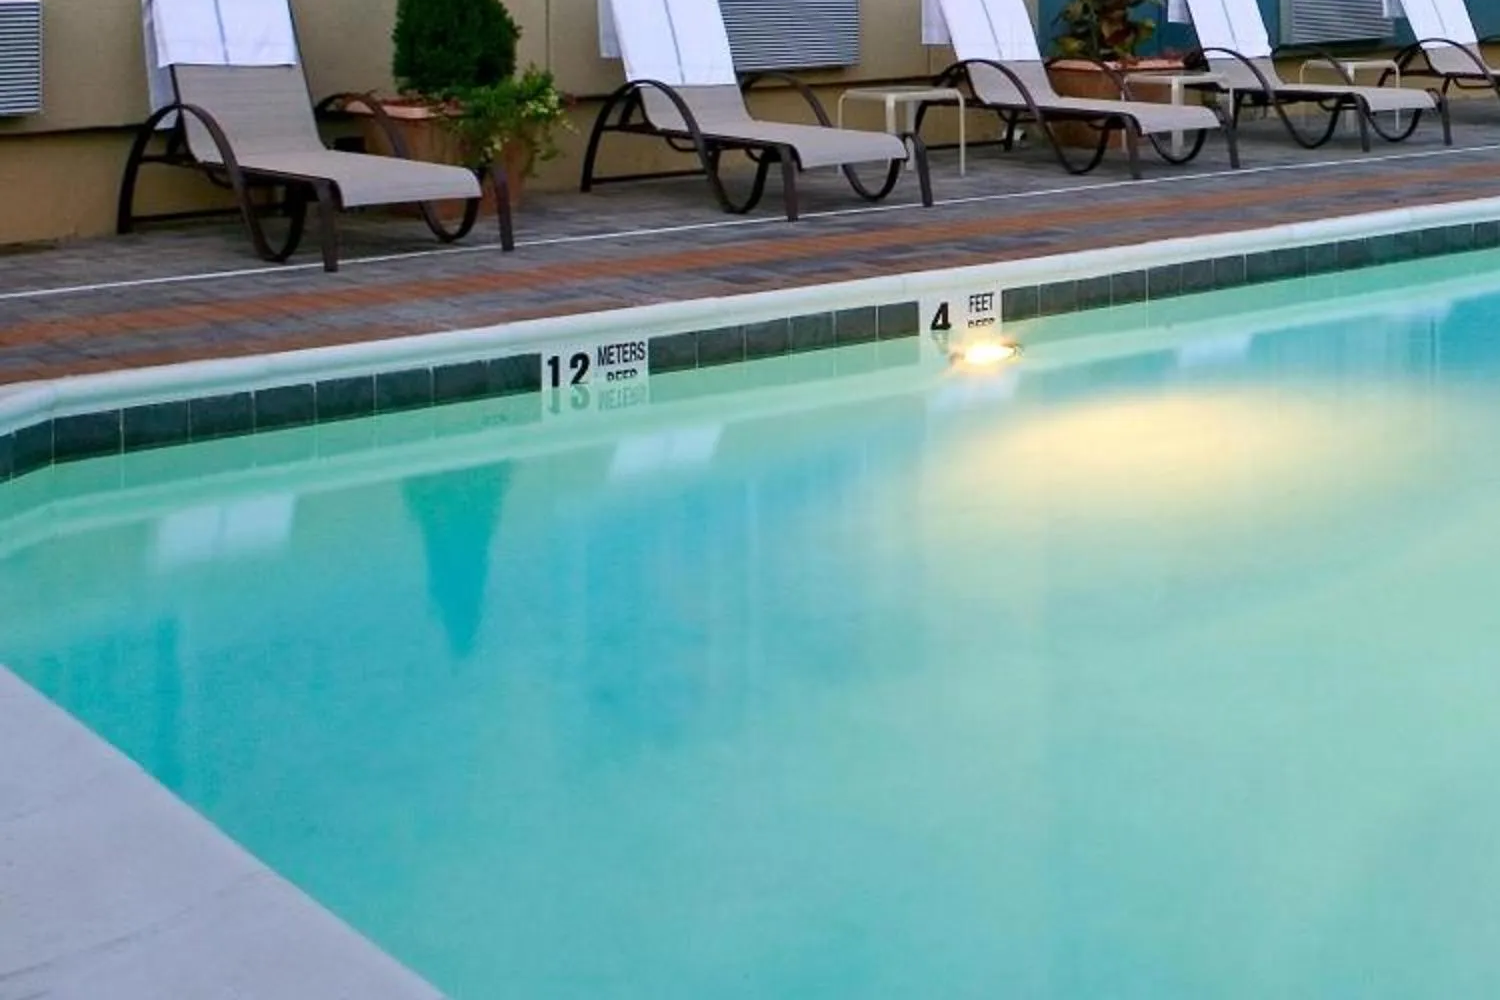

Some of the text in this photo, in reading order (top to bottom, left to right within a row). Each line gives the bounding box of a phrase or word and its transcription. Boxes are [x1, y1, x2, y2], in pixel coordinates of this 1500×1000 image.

[931, 302, 952, 330] 4
[969, 292, 994, 313] FEET
[597, 341, 646, 367] METERS
